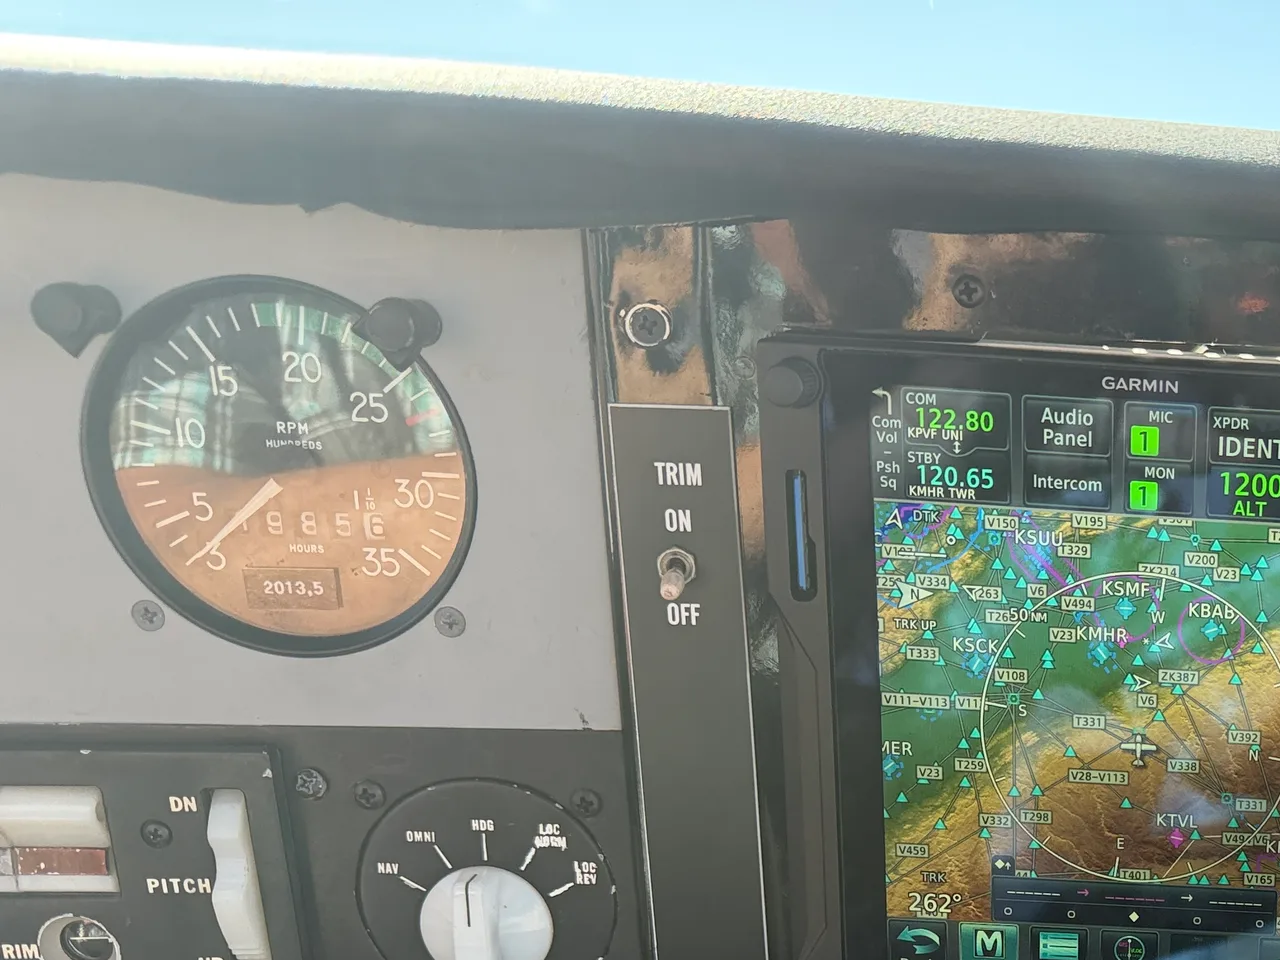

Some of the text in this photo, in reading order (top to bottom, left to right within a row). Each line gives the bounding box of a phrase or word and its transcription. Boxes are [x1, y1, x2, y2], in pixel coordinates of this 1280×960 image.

[283, 353, 321, 383] 20
[209, 365, 238, 396] 15
[1101, 376, 1179, 394] GARMIN
[906, 393, 936, 405] COM
[350, 392, 388, 423] 25
[916, 408, 993, 432] 122.80
[1041, 407, 1093, 425] Audio
[1149, 411, 1173, 423] MIC
[1213, 416, 1249, 430] XPDR
[176, 417, 205, 449] 10
[277, 422, 309, 435] RPM
[1043, 430, 1092, 447] Panel
[908, 451, 941, 464] STBY
[654, 462, 702, 486] TRIM
[917, 465, 994, 489] 120.65
[1145, 467, 1175, 479] MON
[1033, 474, 1102, 492] Intercom
[394, 480, 434, 509] 30
[909, 486, 975, 500] KMHR TWR
[1233, 501, 1267, 517] ALT
[665, 509, 692, 532] ON
[1015, 530, 1063, 545] KSUU
[289, 544, 324, 554] HOURS
[363, 549, 400, 577] 35
[918, 576, 947, 587] V334
[1103, 581, 1150, 597] KSMF
[667, 603, 700, 625] OFF
[1077, 627, 1127, 642] KMHR
[909, 648, 936, 658] T333
[953, 638, 999, 653] KSCK
[884, 695, 947, 707] V111-V113
[1170, 760, 1197, 771] V338
[1071, 771, 1126, 783] V28-V113
[169, 796, 197, 812] DN
[472, 819, 494, 831] HDG
[1157, 814, 1198, 828] KTVL
[406, 831, 436, 843] OMNI
[377, 863, 399, 874] NAV
[146, 878, 211, 894] PITCH
[908, 892, 962, 912] 262°
